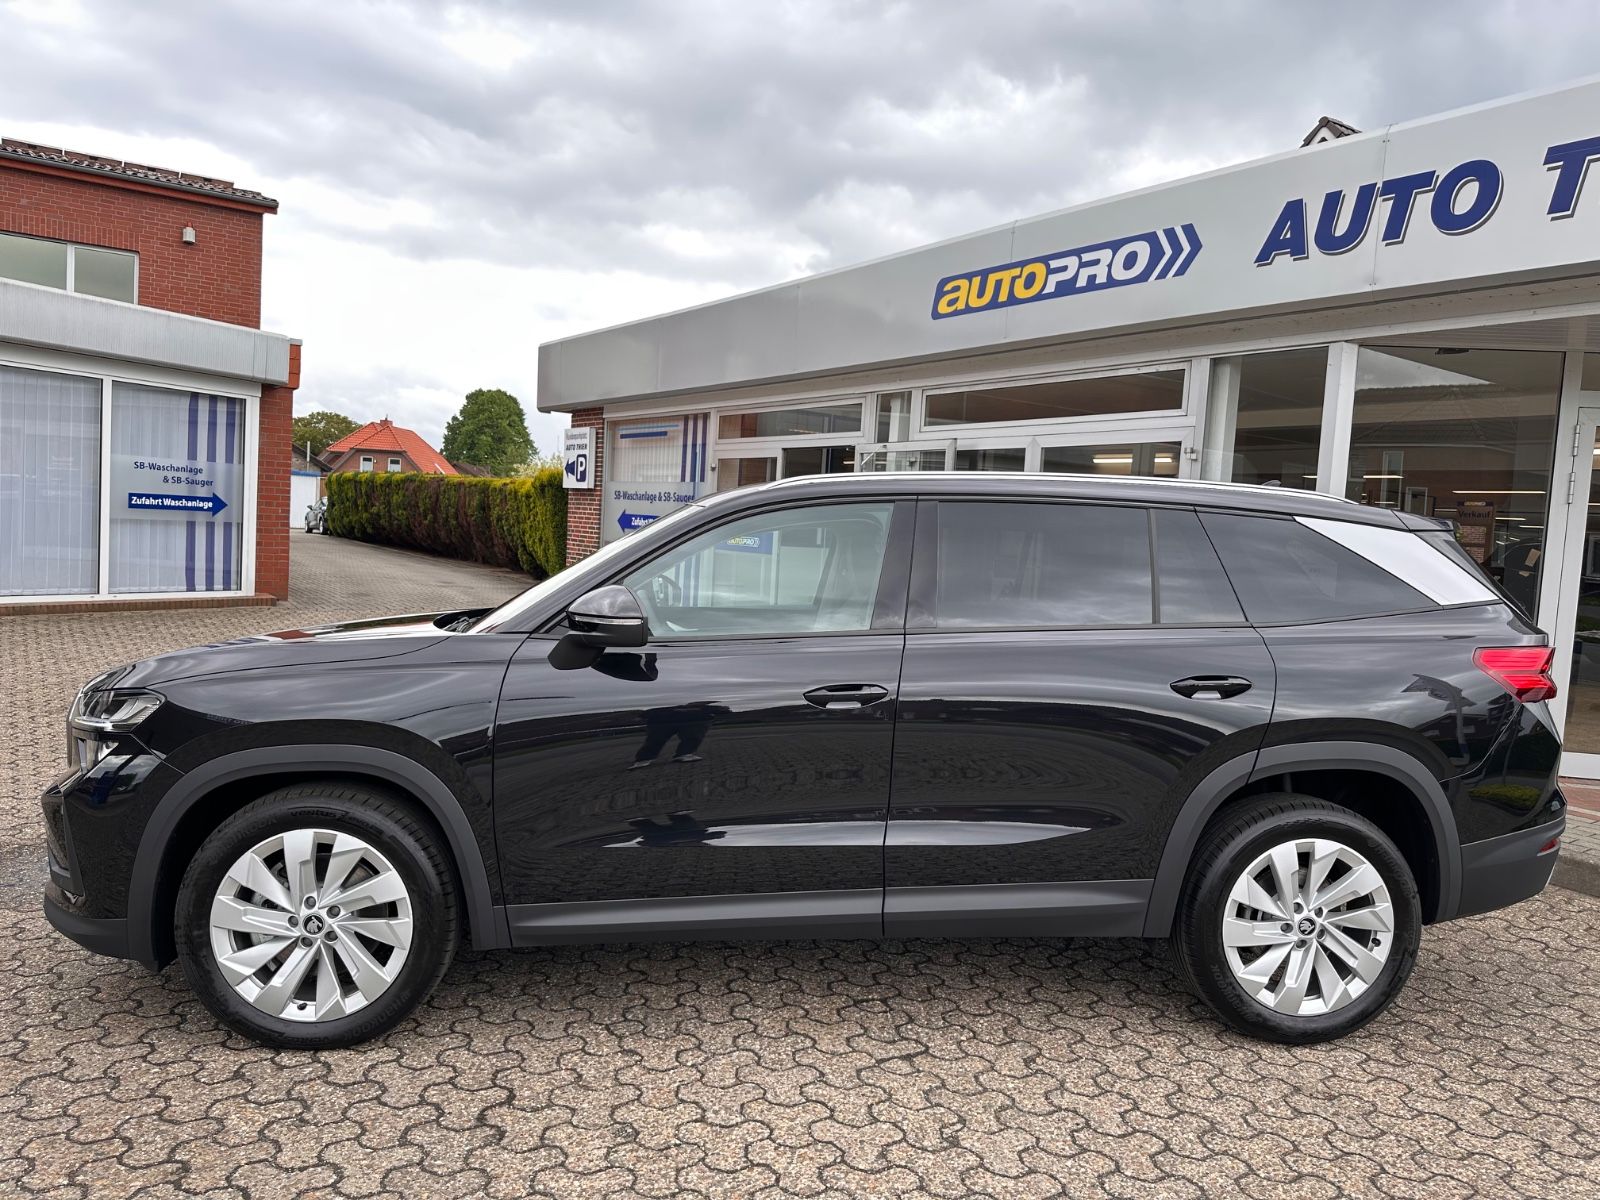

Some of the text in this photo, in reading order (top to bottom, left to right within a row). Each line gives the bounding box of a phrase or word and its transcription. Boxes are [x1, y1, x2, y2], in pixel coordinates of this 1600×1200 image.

[1253, 159, 1504, 269] AUTO
[134, 461, 203, 475] SB-Waschanlage
[577, 456, 586, 480] P
[162, 475, 214, 487] & SB-Sauger
[131, 496, 213, 509] Zufahrt Waschanlage
[614, 490, 657, 504] SB-Waschanlage
[657, 492, 663, 502] &
[1459, 511, 1492, 519] Verkauf
